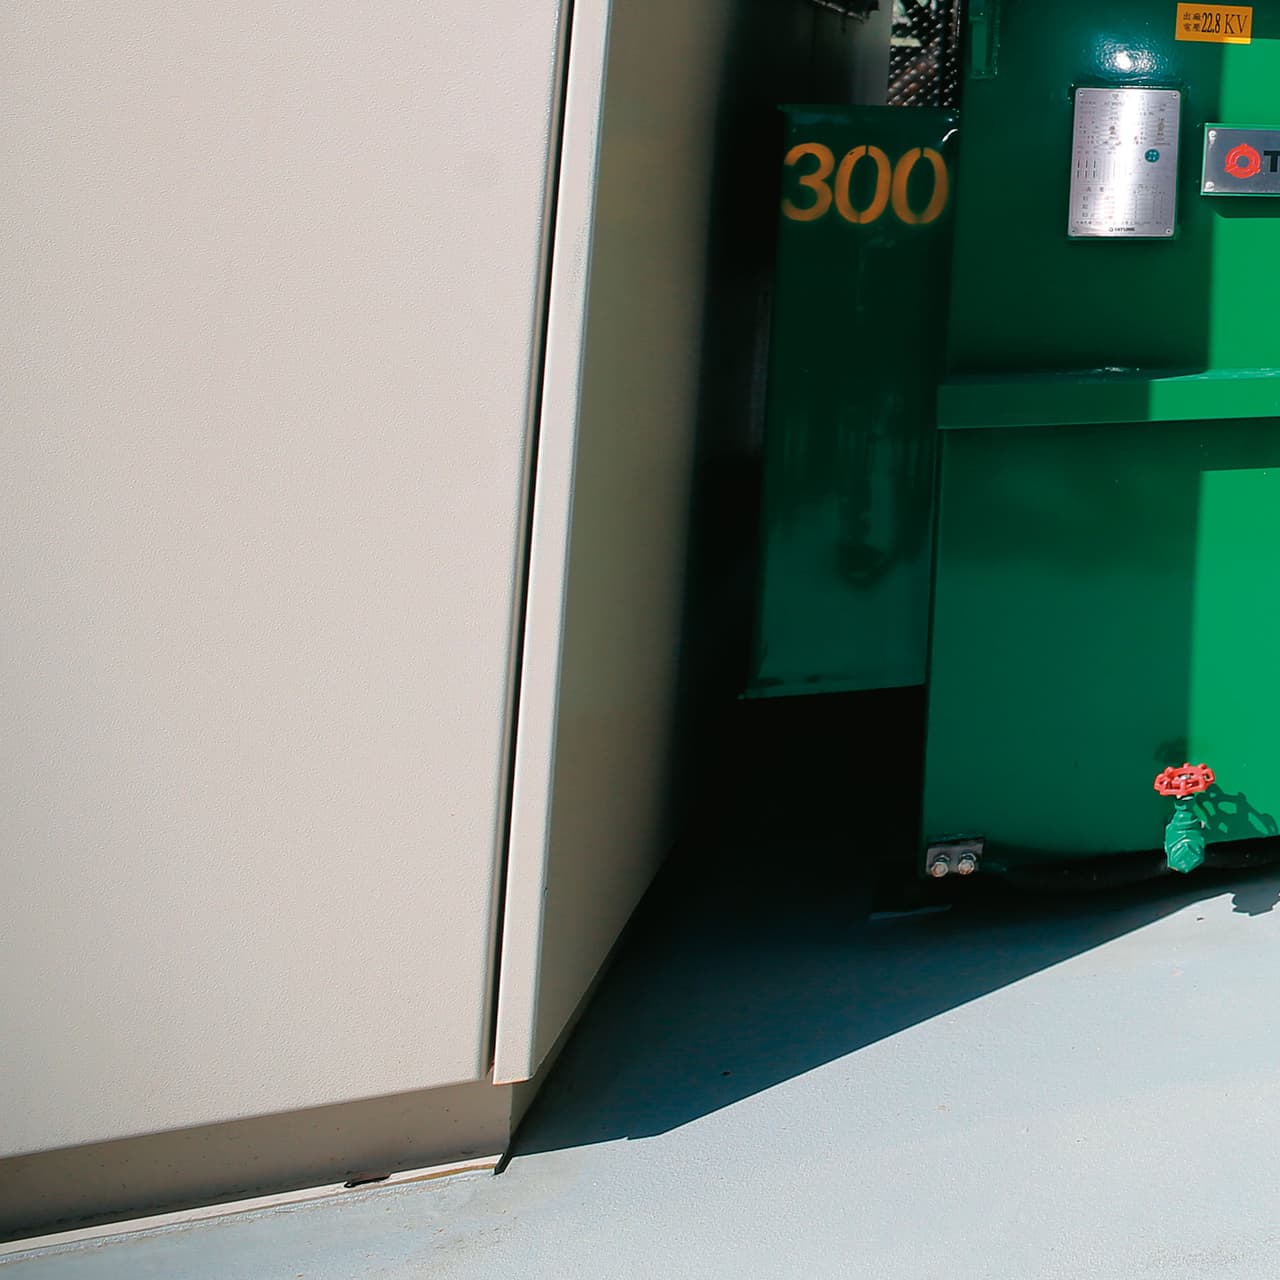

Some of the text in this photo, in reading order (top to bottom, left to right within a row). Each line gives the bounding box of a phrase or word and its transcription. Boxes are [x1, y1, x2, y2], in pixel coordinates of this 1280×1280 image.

[1201, 12, 1248, 34] 22.8 KV
[782, 142, 948, 225] 300
